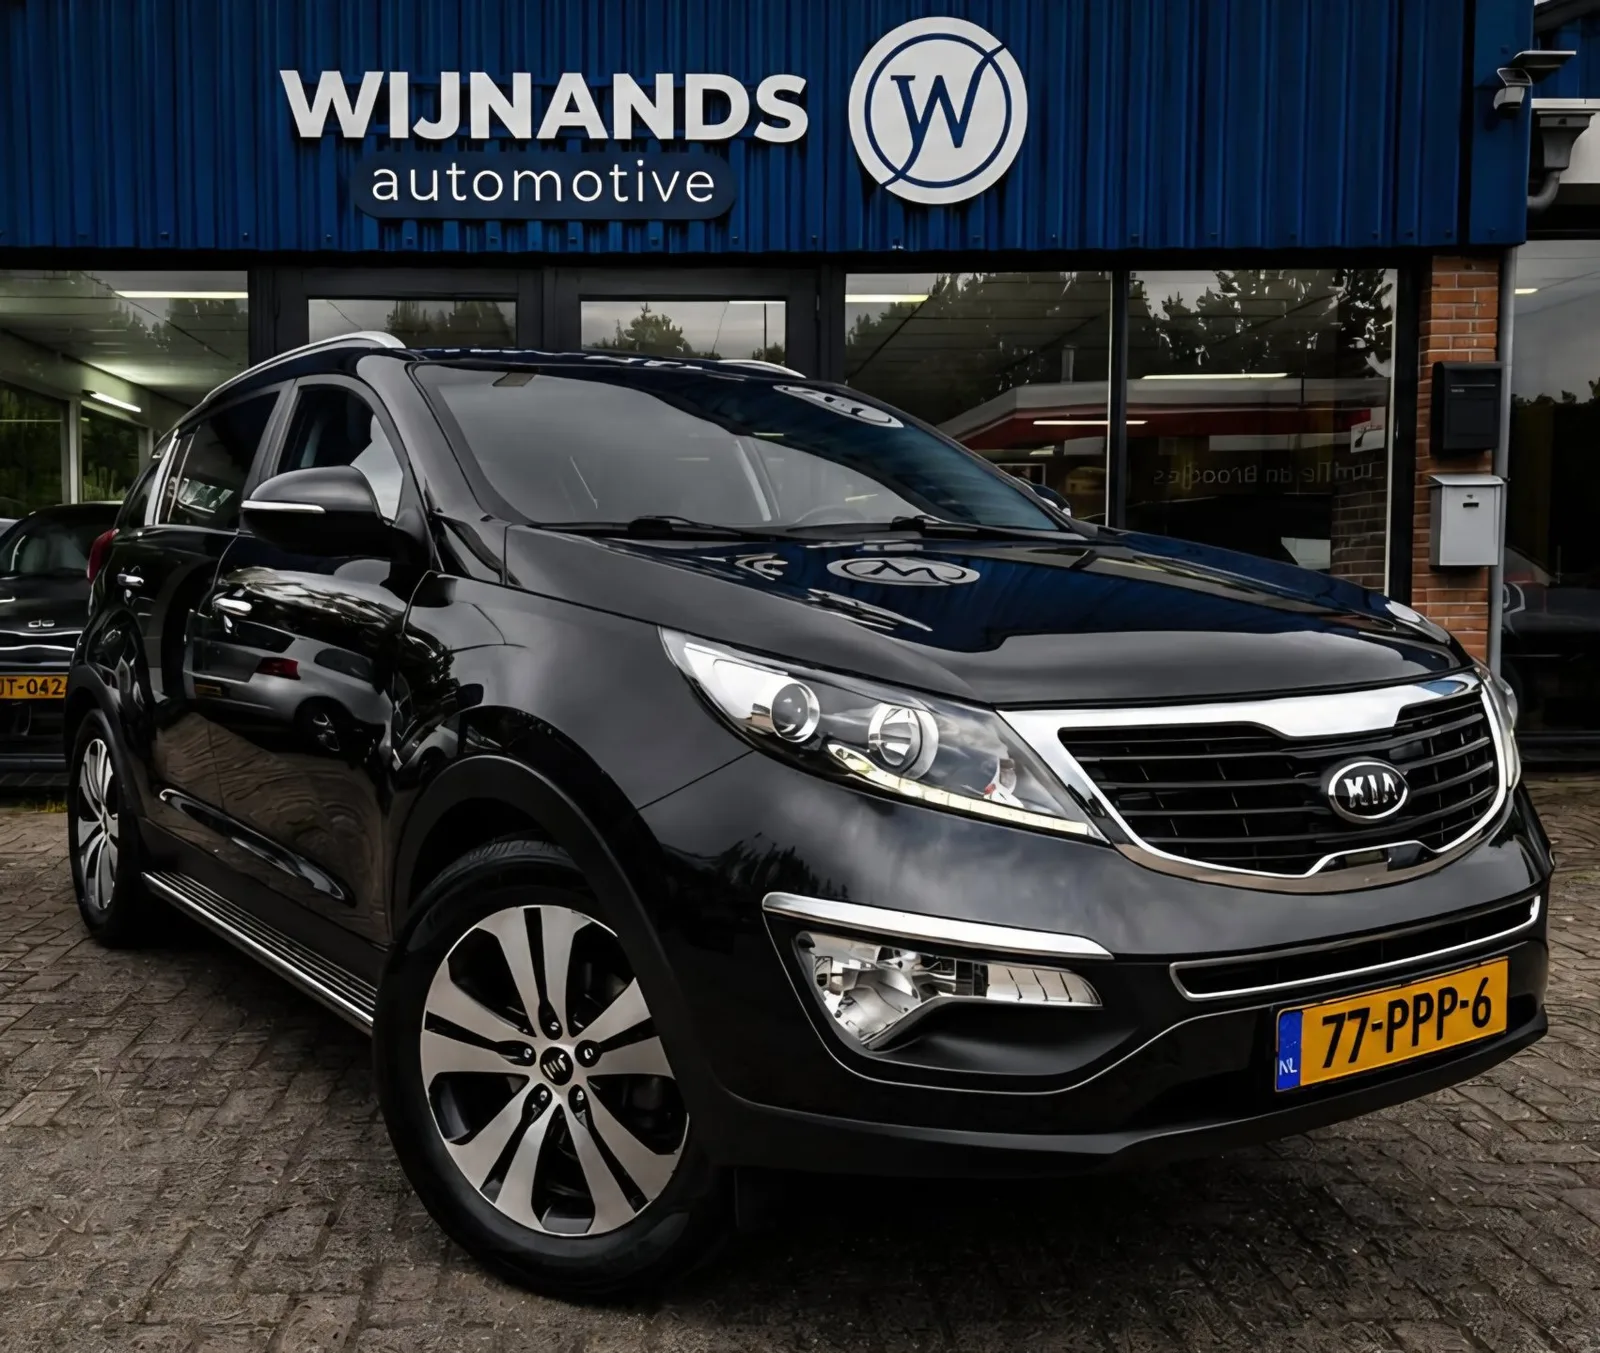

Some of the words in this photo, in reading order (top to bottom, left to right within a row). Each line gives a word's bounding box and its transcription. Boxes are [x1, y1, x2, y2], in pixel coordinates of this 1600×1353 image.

[279, 69, 809, 143] WIJNANDS
[371, 159, 715, 202] automotive
[1343, 772, 1398, 808] KIA
[1321, 976, 1492, 1068] 77-PPP-6
[1278, 1057, 1298, 1076] NL
